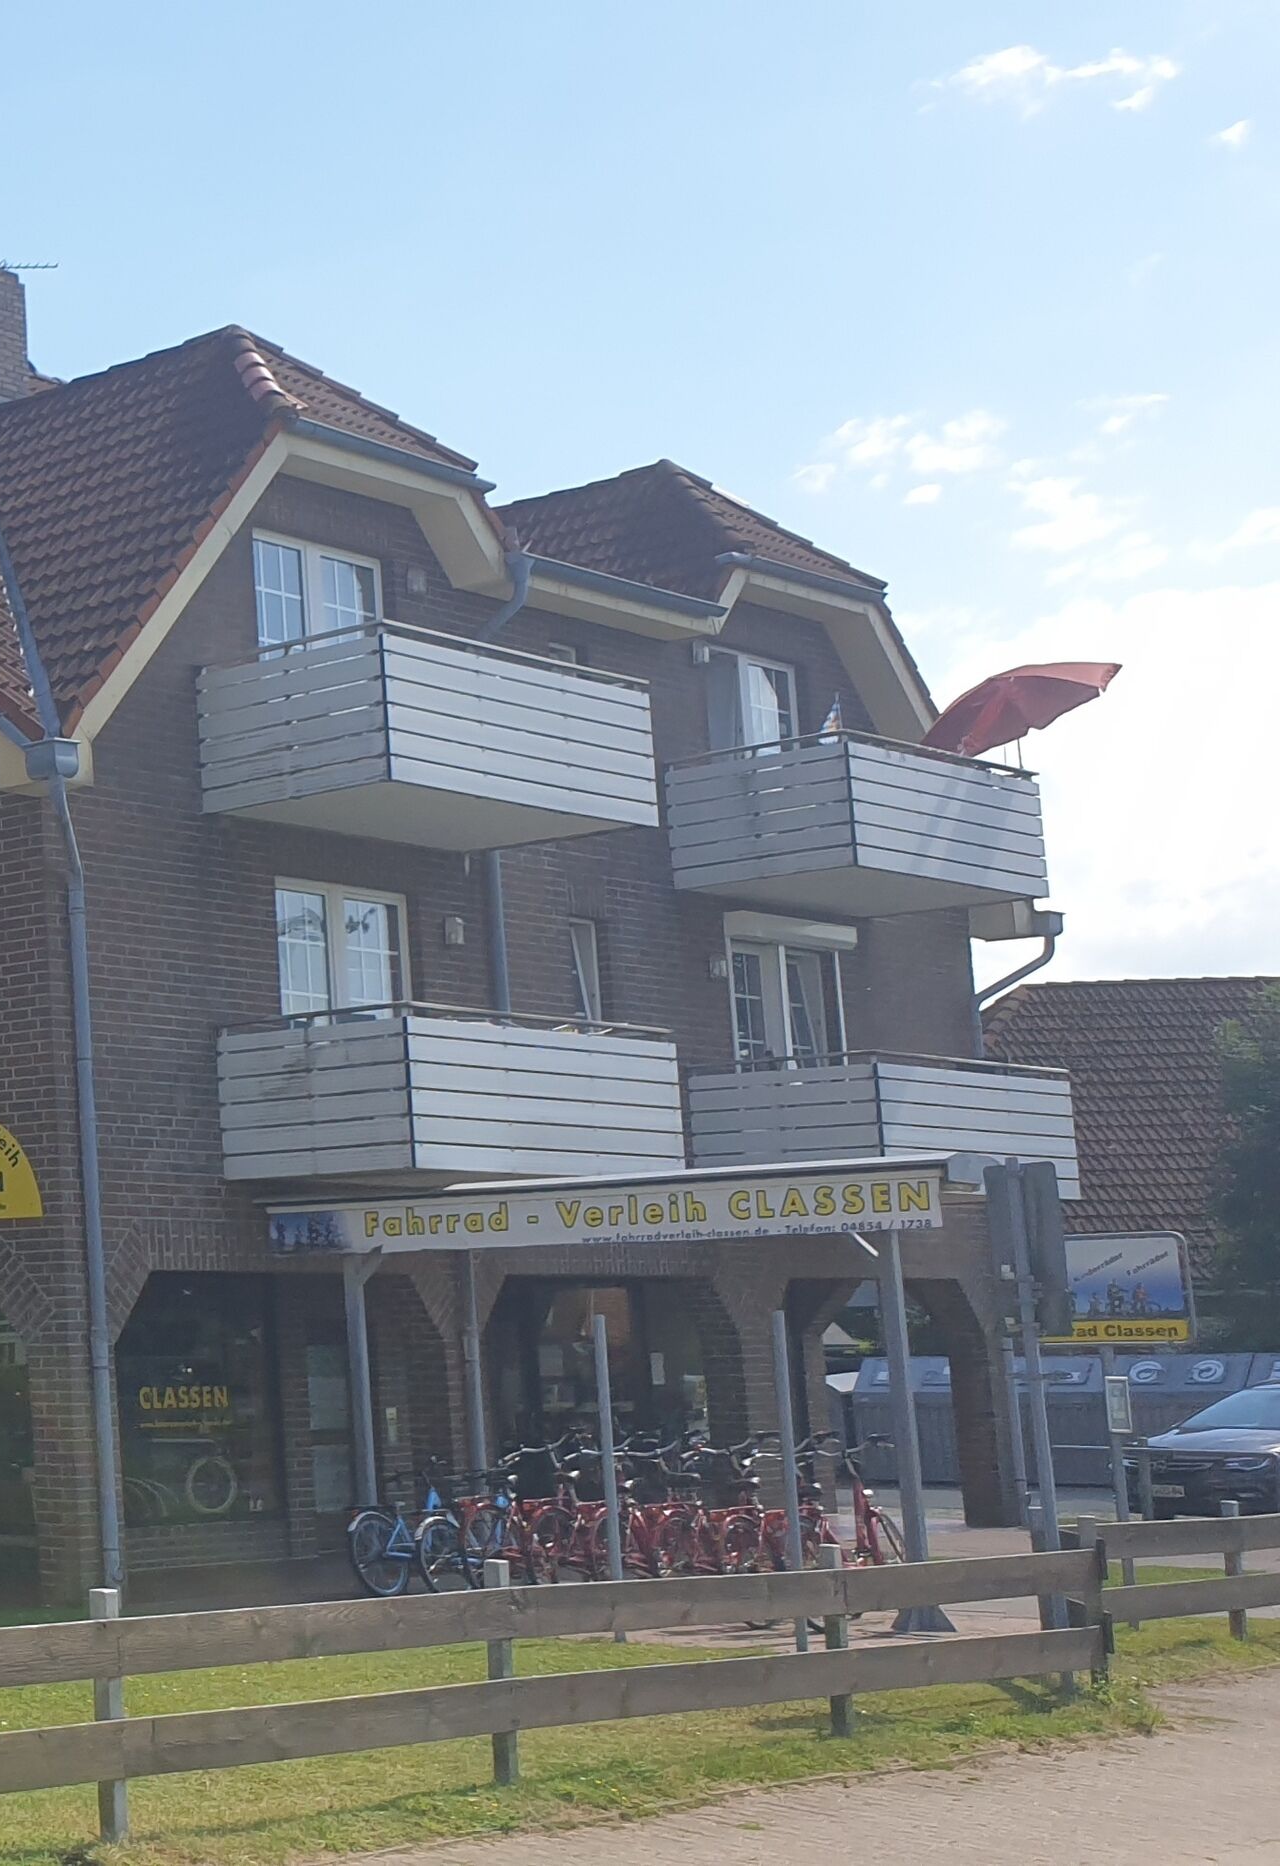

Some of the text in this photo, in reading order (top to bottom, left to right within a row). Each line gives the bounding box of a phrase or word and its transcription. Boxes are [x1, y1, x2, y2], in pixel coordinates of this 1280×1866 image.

[364, 1201, 509, 1238] Fahrrad
[555, 1191, 707, 1229] Verleih
[728, 1181, 931, 1220] CLASSEN
[1104, 1324, 1179, 1337] Classen
[140, 1386, 229, 1409] CLASSEN
